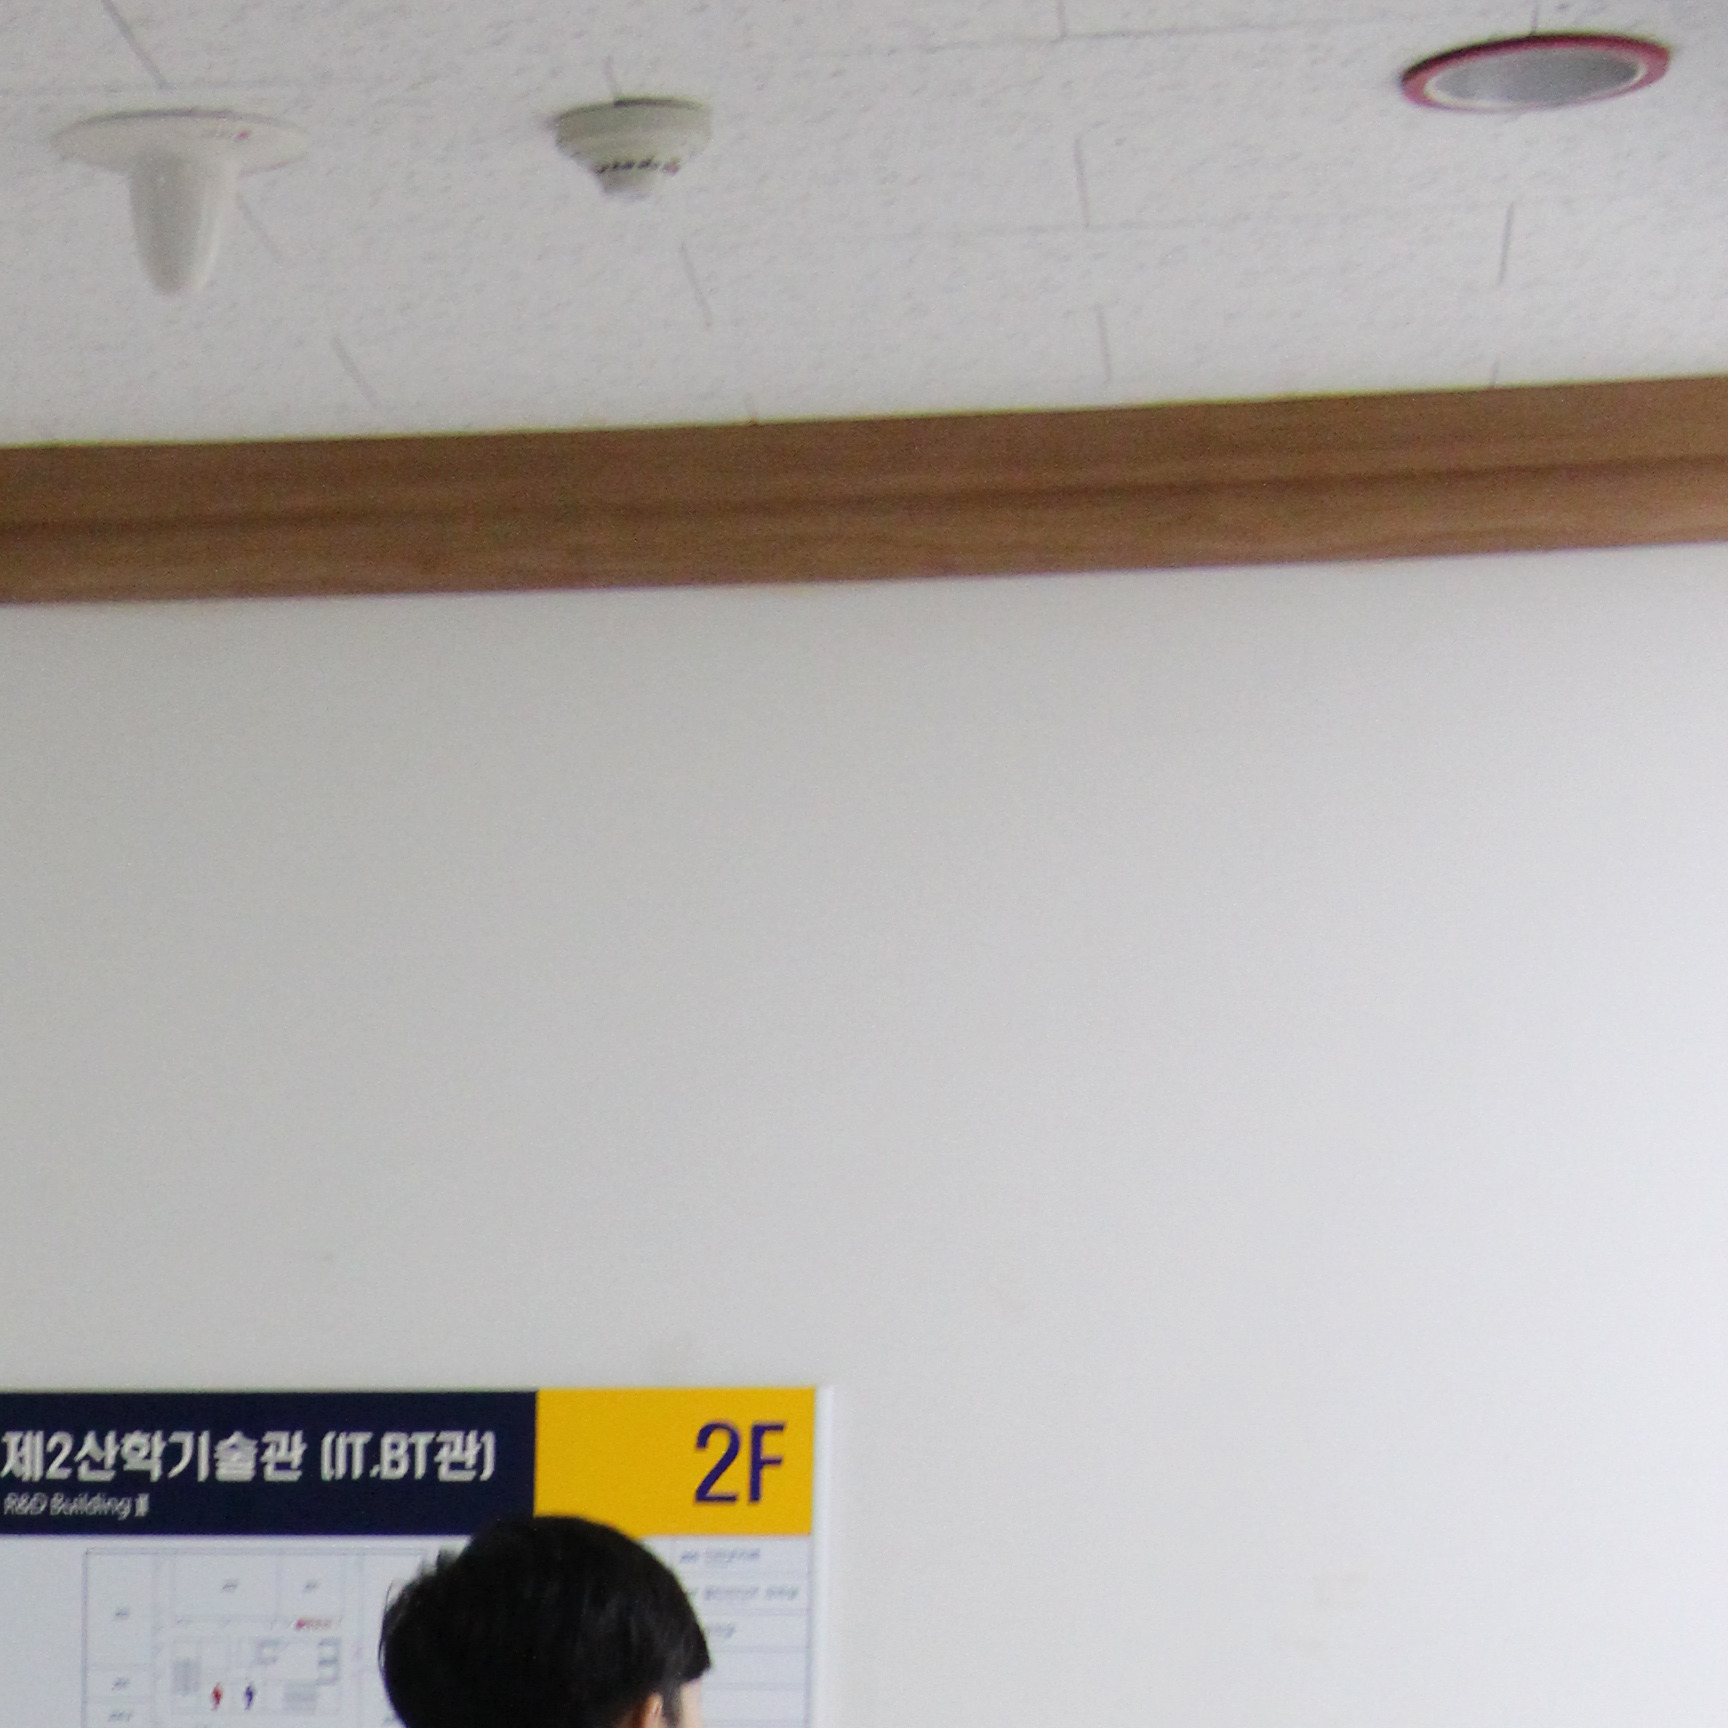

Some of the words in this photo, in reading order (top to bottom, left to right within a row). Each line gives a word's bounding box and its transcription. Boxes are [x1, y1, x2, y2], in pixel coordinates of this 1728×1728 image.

[0, 1430, 307, 1482] 제2산학기술관
[320, 1430, 496, 1482] (IT.BT관)
[695, 1422, 785, 1503] 2F
[4, 1492, 48, 1516] R&D
[49, 1492, 132, 1521] Building
